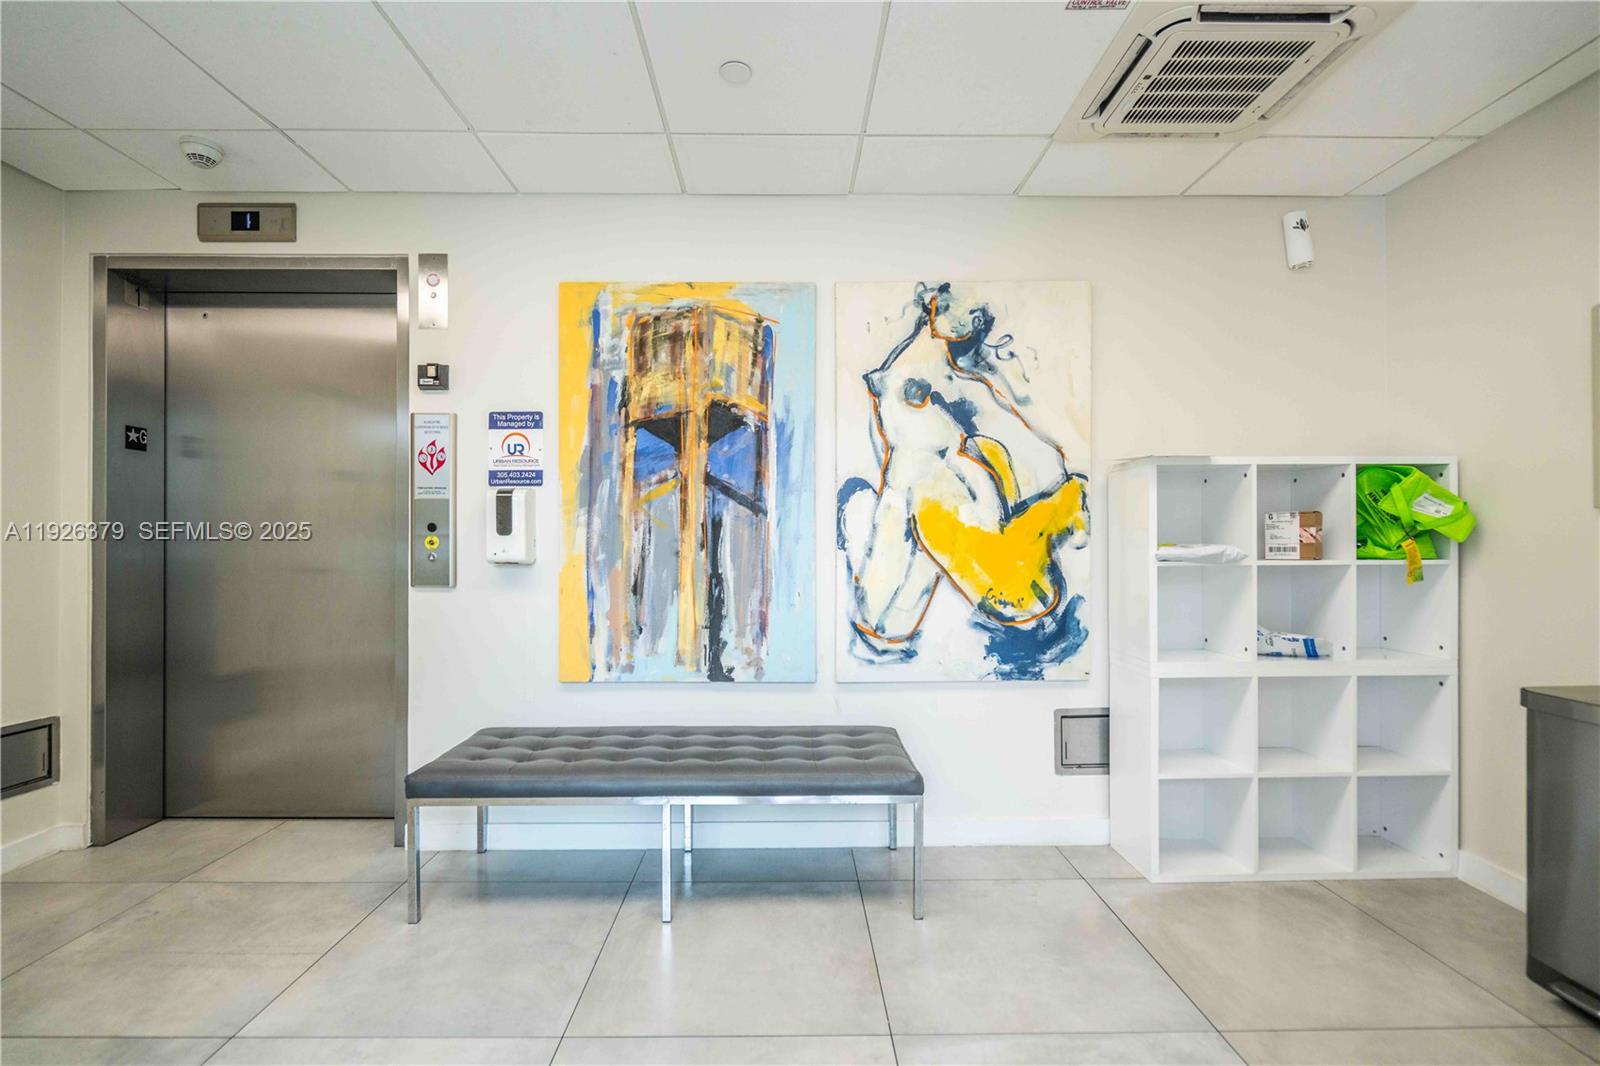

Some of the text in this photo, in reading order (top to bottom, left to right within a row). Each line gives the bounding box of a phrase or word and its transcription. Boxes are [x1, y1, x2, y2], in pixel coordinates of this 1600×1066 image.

[507, 414, 533, 422] Property
[140, 430, 147, 444] G
[507, 444, 525, 455] UR
